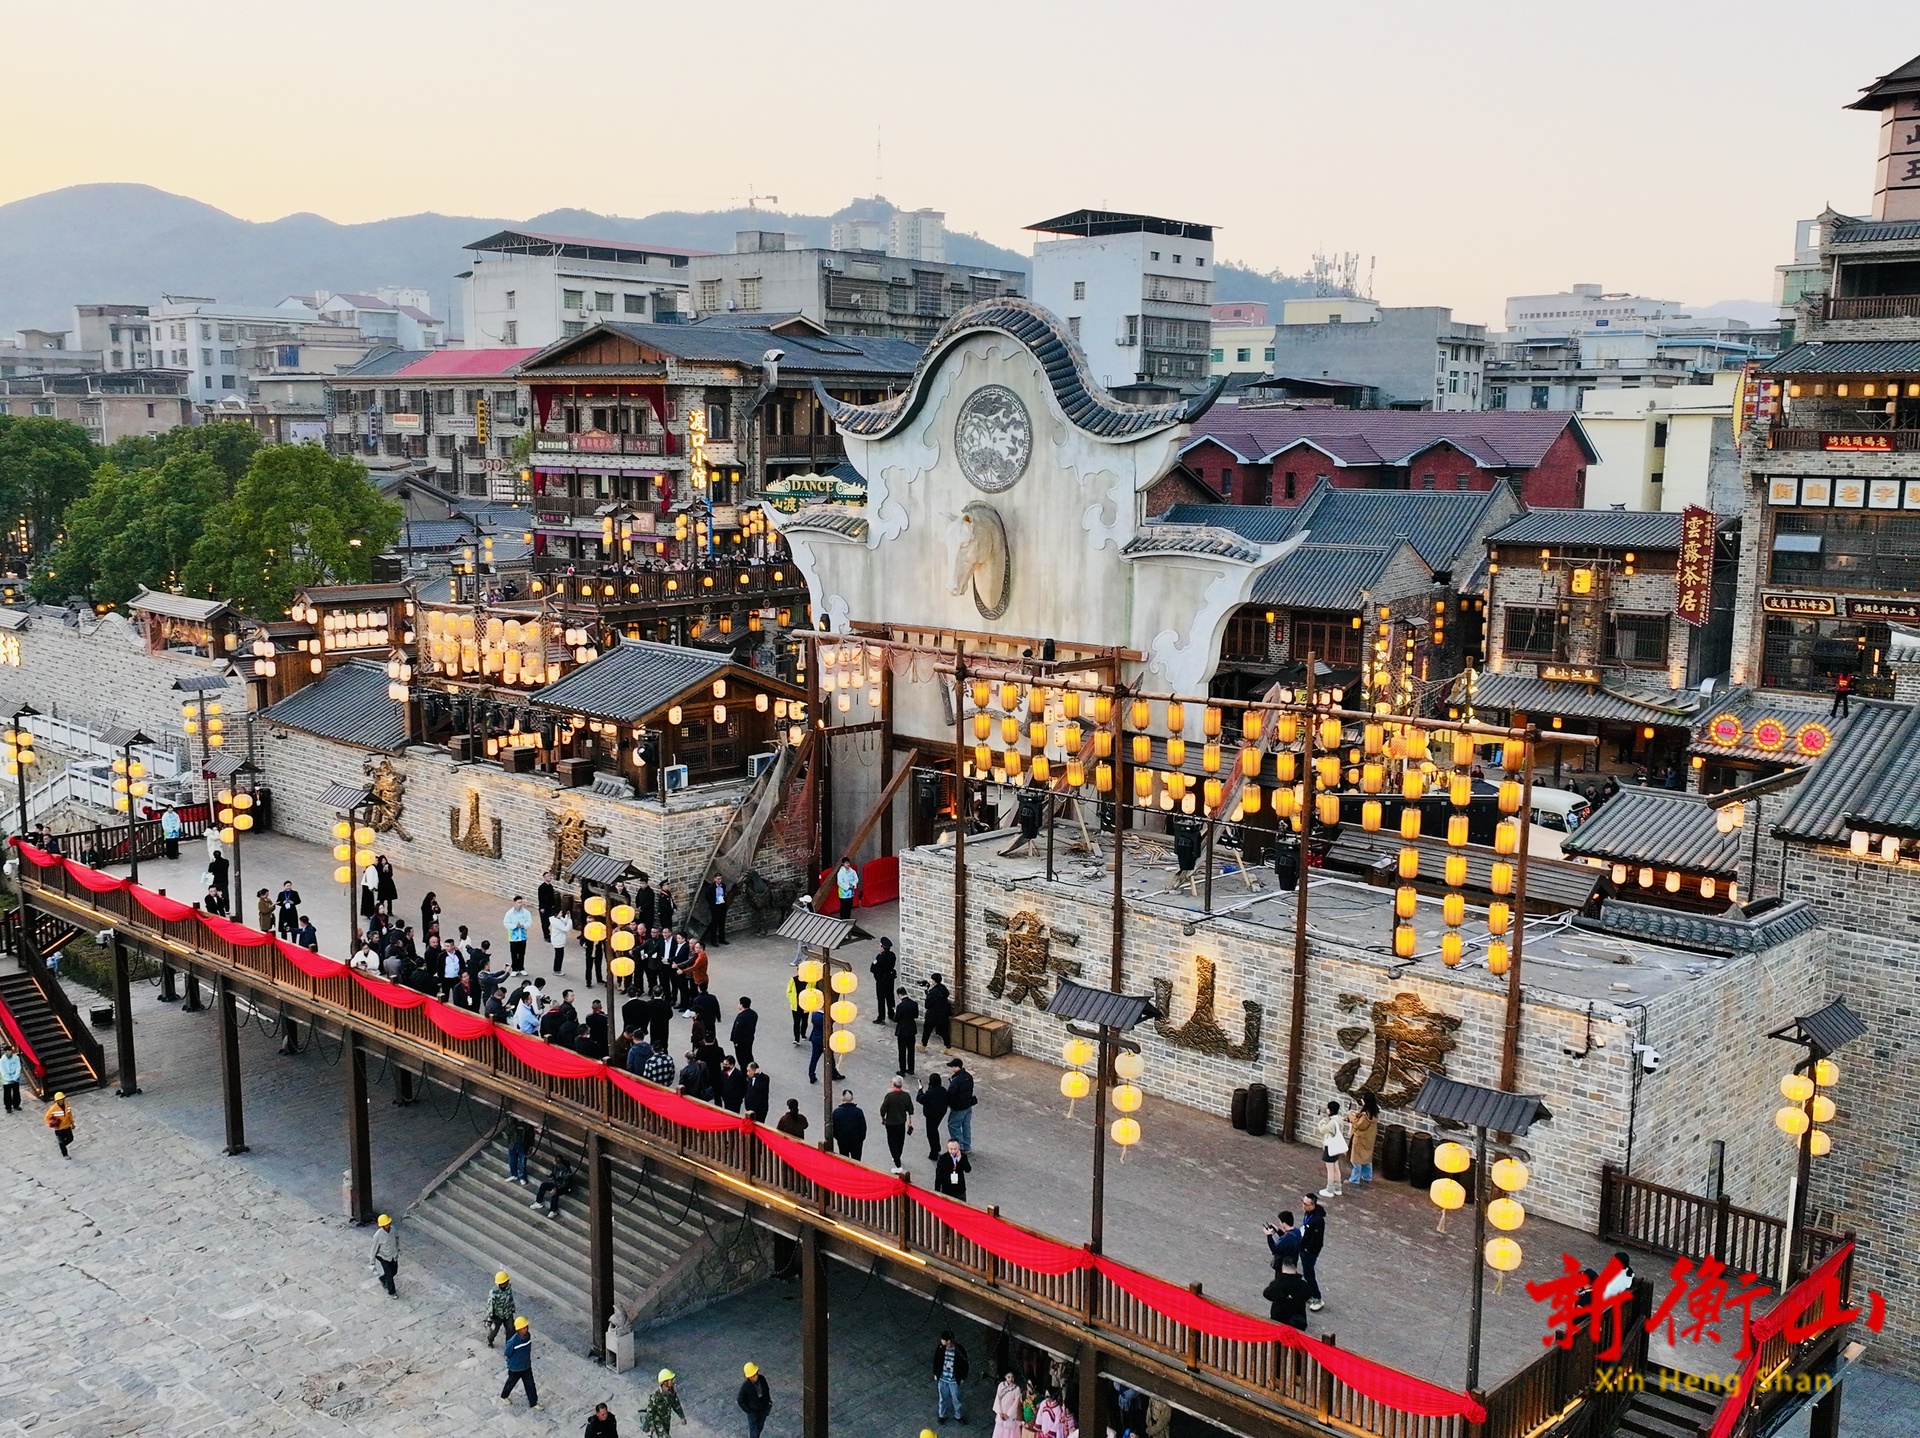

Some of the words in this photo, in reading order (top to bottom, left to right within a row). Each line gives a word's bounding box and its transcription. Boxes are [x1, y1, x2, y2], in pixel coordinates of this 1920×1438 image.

[791, 480, 834, 492] DANCE
[1679, 516, 1705, 613] 雲霧茶居
